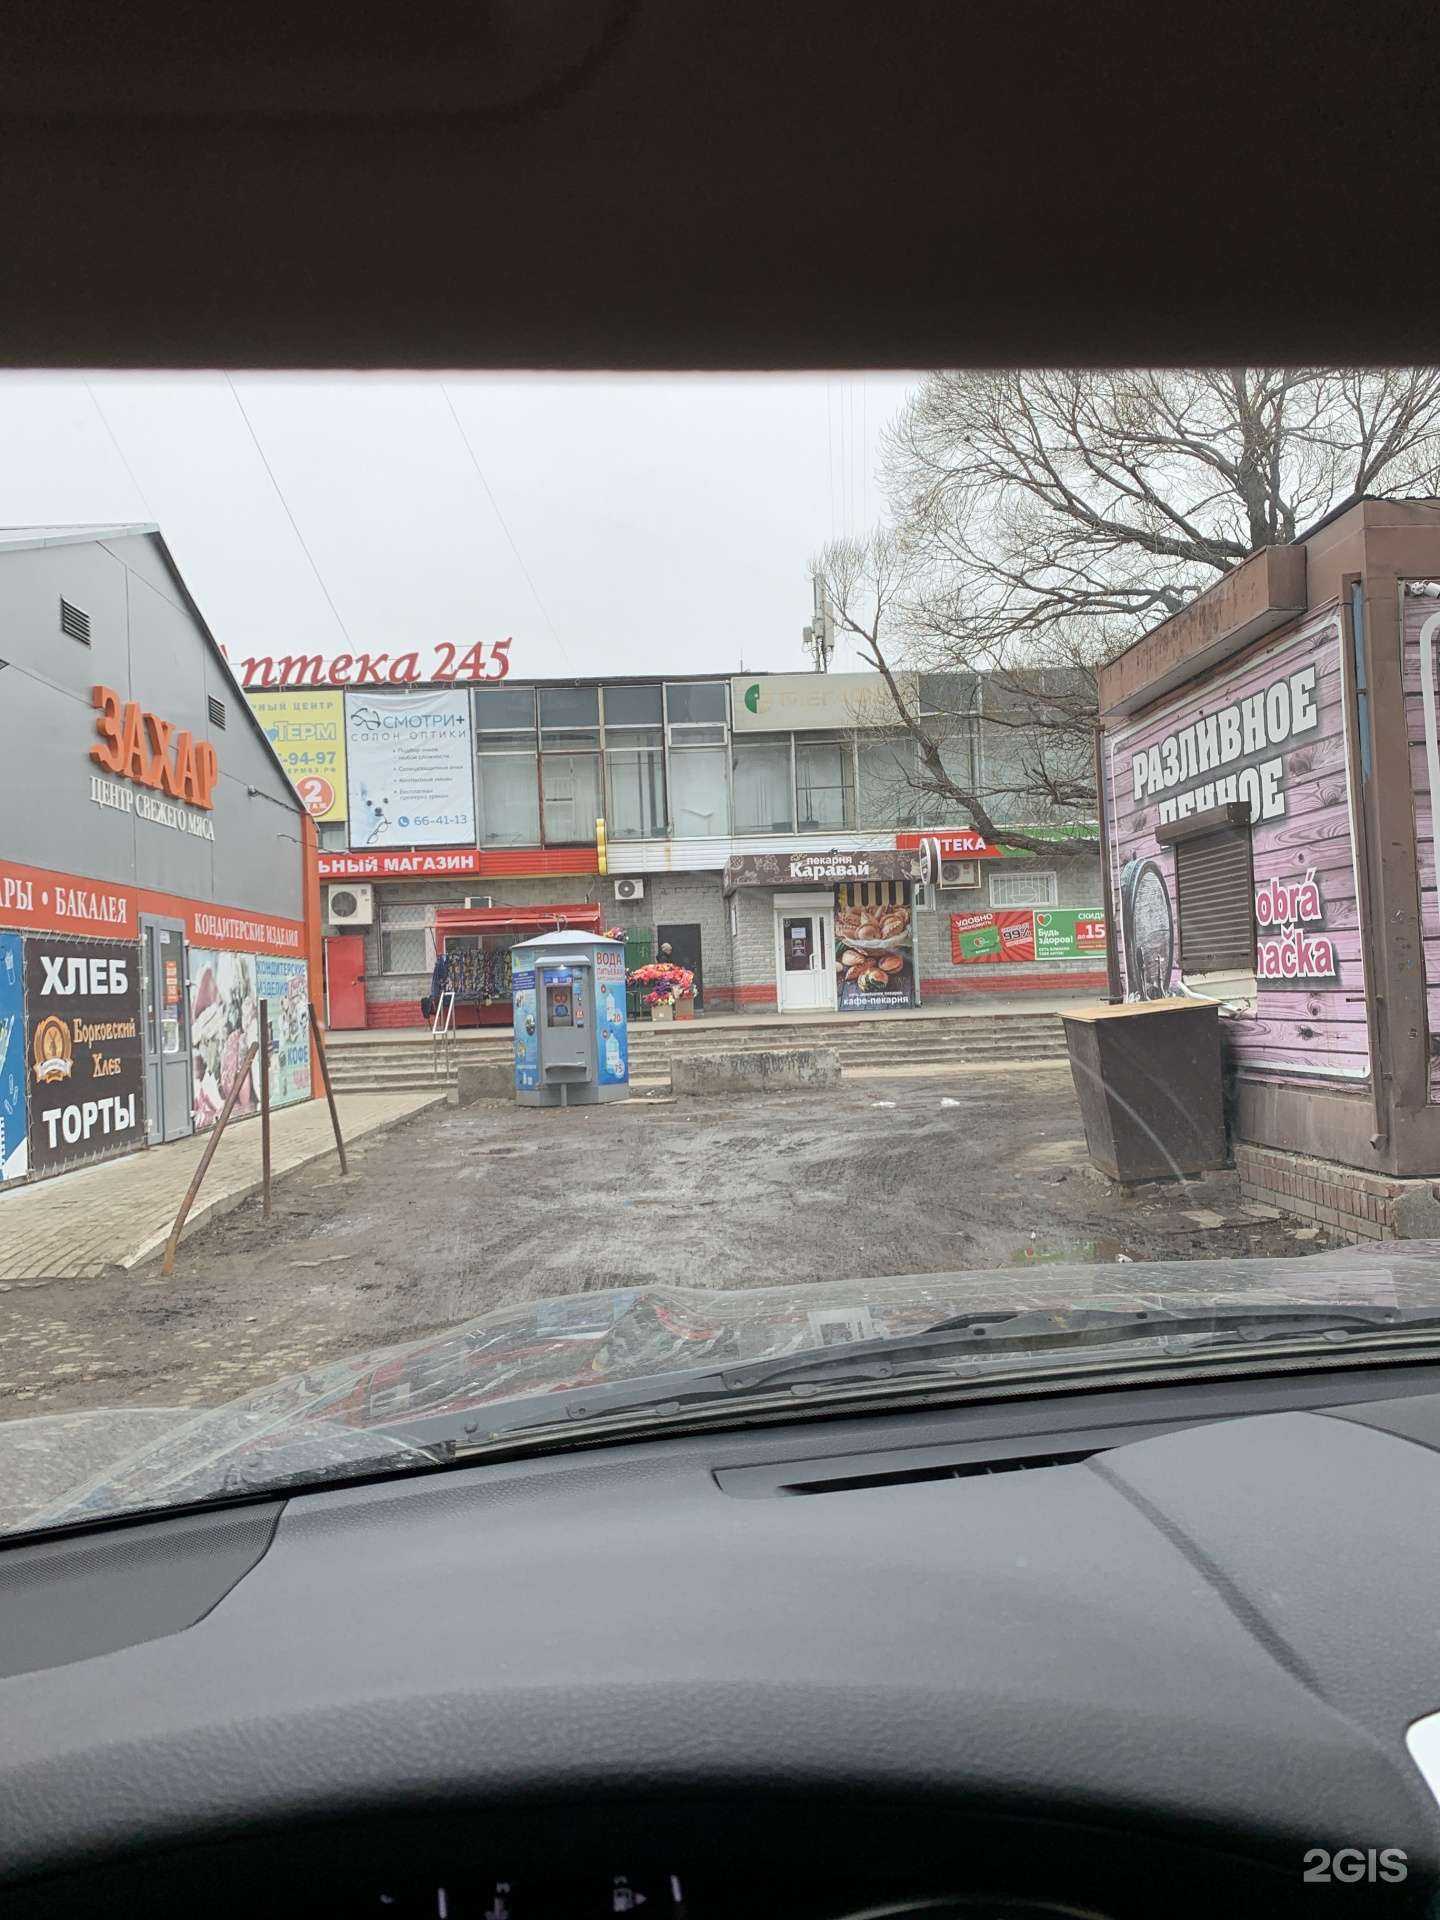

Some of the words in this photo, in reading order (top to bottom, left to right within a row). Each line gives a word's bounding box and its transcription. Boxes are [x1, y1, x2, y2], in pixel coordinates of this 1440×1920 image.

[222, 644, 422, 688] птека
[431, 637, 514, 682] 245
[293, 700, 334, 711] ЦЕНТР
[1132, 664, 1318, 802] РАЗЛИВНОЕ
[89, 684, 218, 811] ЗАХАР
[278, 751, 337, 766] -94-97
[304, 779, 323, 803] 2
[90, 776, 134, 813] ЦЕНТР
[135, 793, 187, 832] СВЕЖЕГО
[187, 814, 215, 841] МЯСА
[413, 814, 468, 827] 66-41-13
[936, 837, 987, 852] ТЕКА
[383, 854, 475, 872] МАГАЗИН
[790, 861, 870, 881] Каравай
[806, 856, 853, 865] пекарня
[54, 886, 128, 924] БАКАЛЕЯ
[1257, 867, 1322, 925] obrá
[194, 912, 265, 943] КОНДИТЕРСКИЕ
[266, 929, 299, 948] ИЗДЕЛИЯ
[955, 913, 993, 927] УДОБНО
[1038, 928, 1060, 937] Будь
[1038, 935, 1074, 946] здоров!
[596, 952, 622, 966] ВОДА
[1257, 924, 1335, 977] načka
[40, 955, 129, 995] ХЛЕБ
[256, 960, 306, 978] КОНДИТЕРСКИЕ
[843, 996, 909, 1007] кафе-пекарня
[72, 1017, 136, 1049] Борковский
[92, 1053, 122, 1078] Хлеб
[287, 1045, 309, 1066] КОФЕ
[42, 1093, 136, 1149] ТОРТЫ
